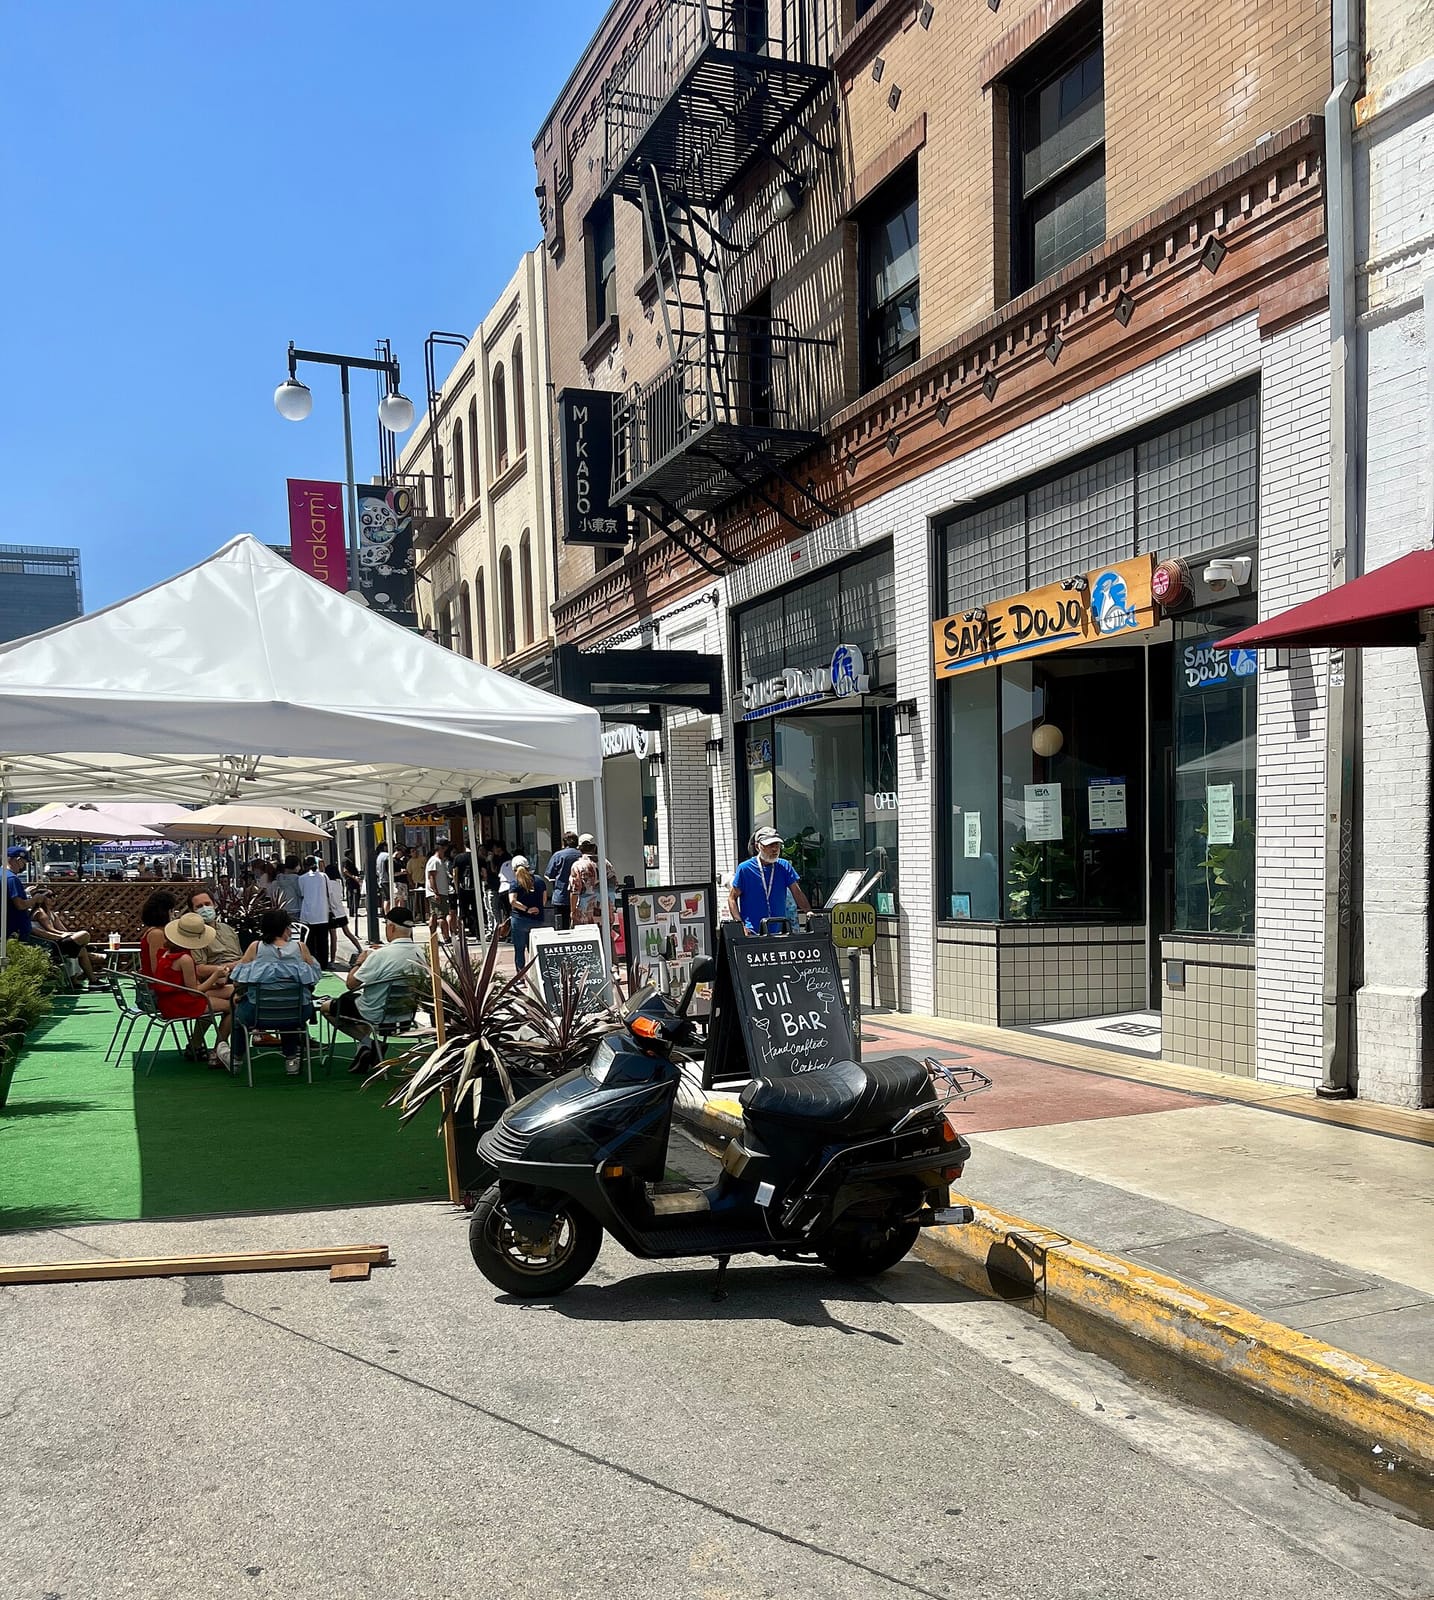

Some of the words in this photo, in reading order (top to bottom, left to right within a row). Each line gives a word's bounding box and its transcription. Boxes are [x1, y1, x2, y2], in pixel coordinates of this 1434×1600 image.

[572, 404, 591, 515] MIKADO
[578, 518, 618, 534] 小東京
[304, 491, 329, 582] urakami
[943, 616, 1007, 657] SAKE
[1008, 599, 1082, 640] DOJO
[1183, 645, 1228, 668] SAKE
[1185, 662, 1228, 687] DOJO
[880, 897, 889, 913] A
[833, 911, 874, 925] LOADING
[842, 926, 865, 939] ONLY
[543, 946, 564, 954] SAKE
[572, 944, 593, 952] DOJO
[746, 951, 777, 963] SAKE
[789, 949, 821, 960] DOJO
[790, 965, 831, 983] Japanese
[806, 976, 835, 992] Beer
[750, 981, 792, 1010] Full
[781, 1010, 827, 1037] BAR
